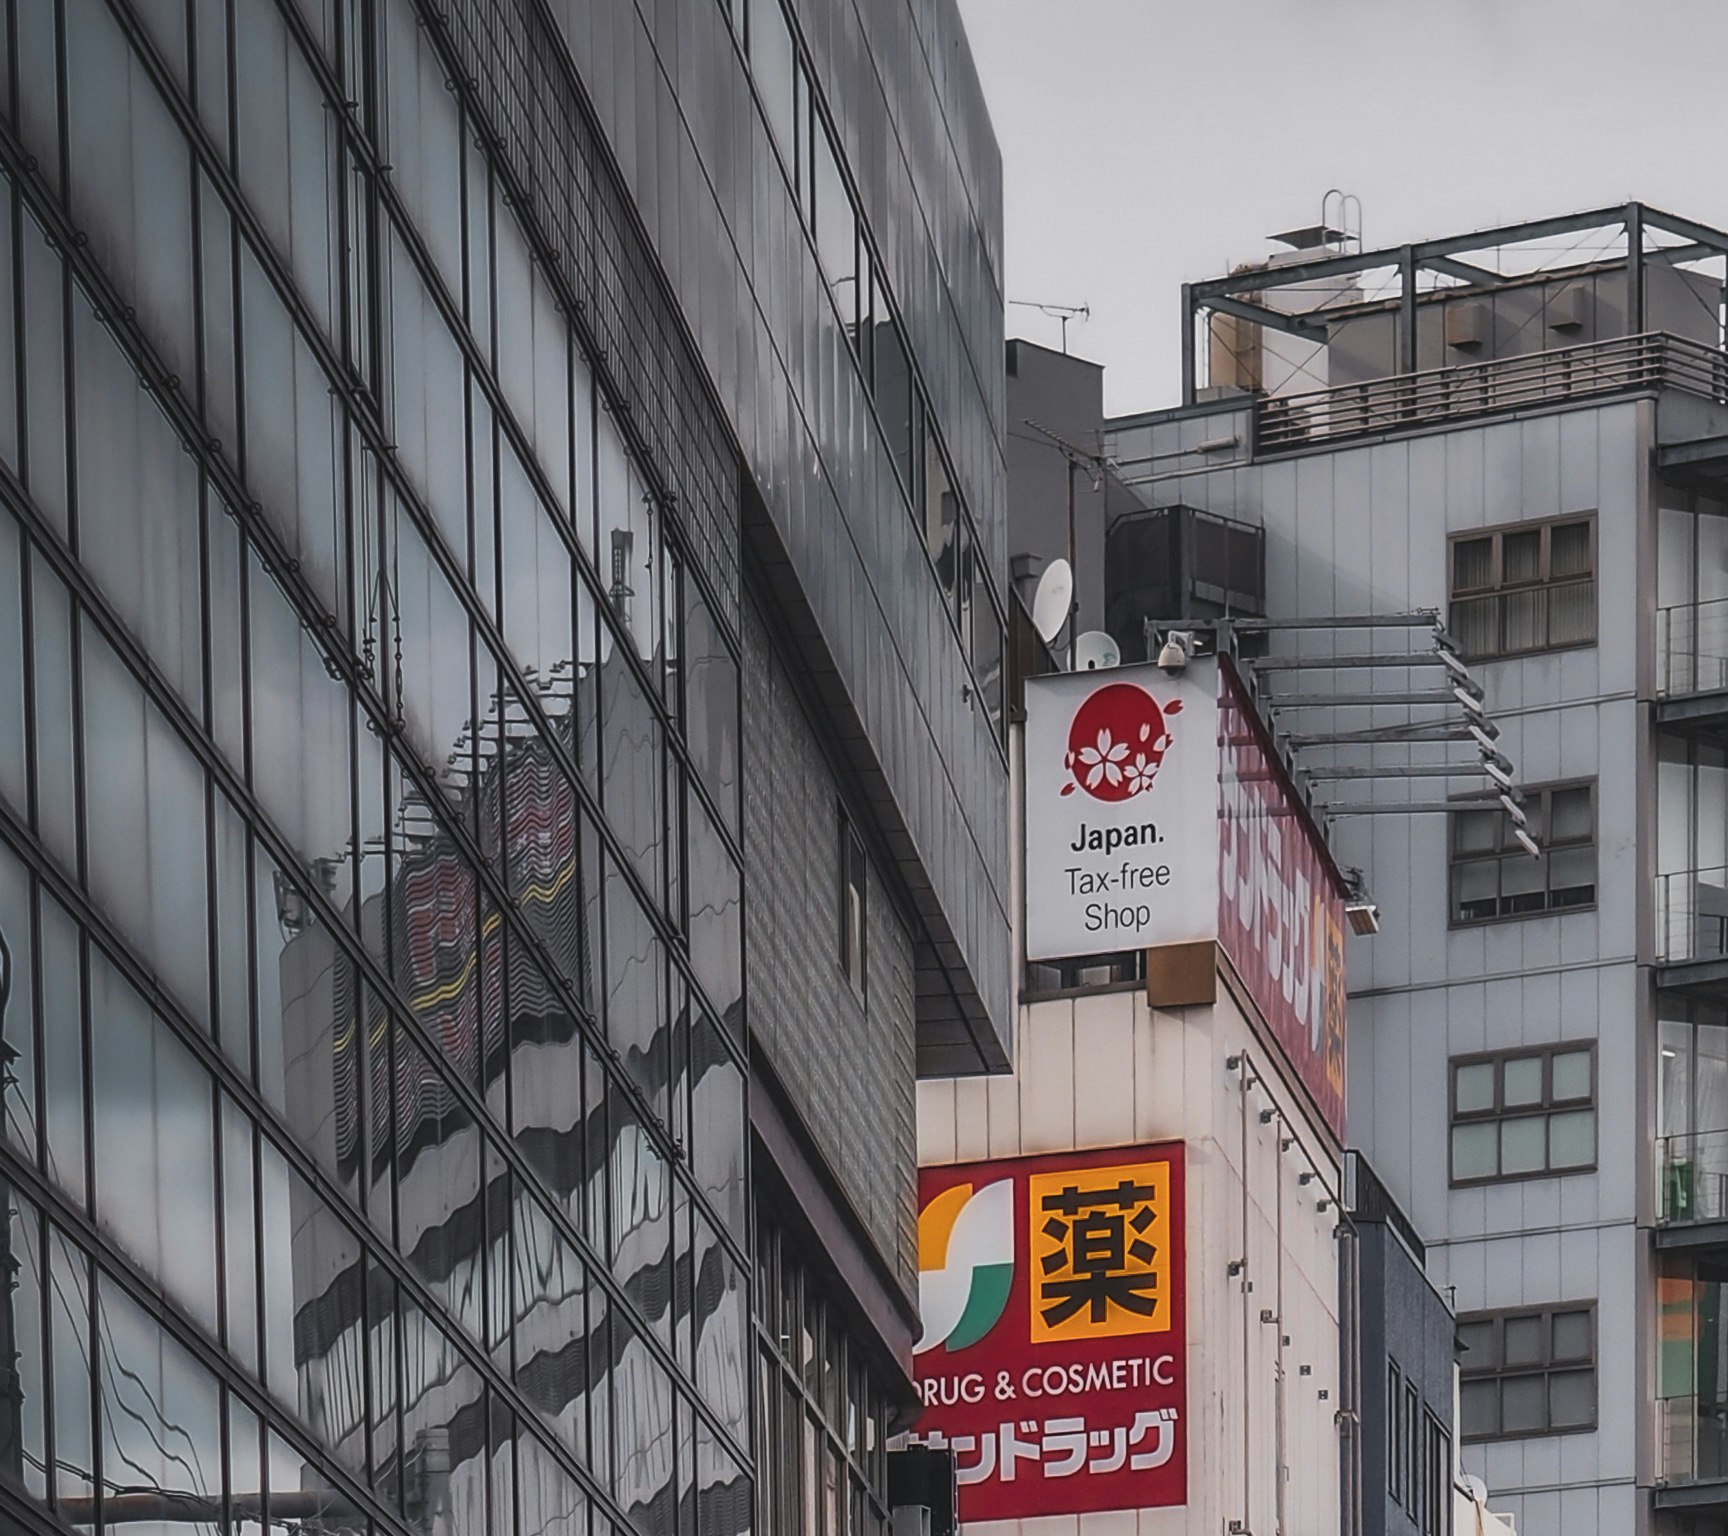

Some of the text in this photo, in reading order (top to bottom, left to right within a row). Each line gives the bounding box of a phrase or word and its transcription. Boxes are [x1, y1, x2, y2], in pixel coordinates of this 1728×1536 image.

[1070, 819, 1165, 855] Japan.
[1064, 862, 1171, 896] Tax-free
[1084, 902, 1151, 932] Shop
[1041, 1180, 1157, 1327] 薬
[994, 1371, 1016, 1400] &
[1022, 1356, 1174, 1397] COSMETIC
